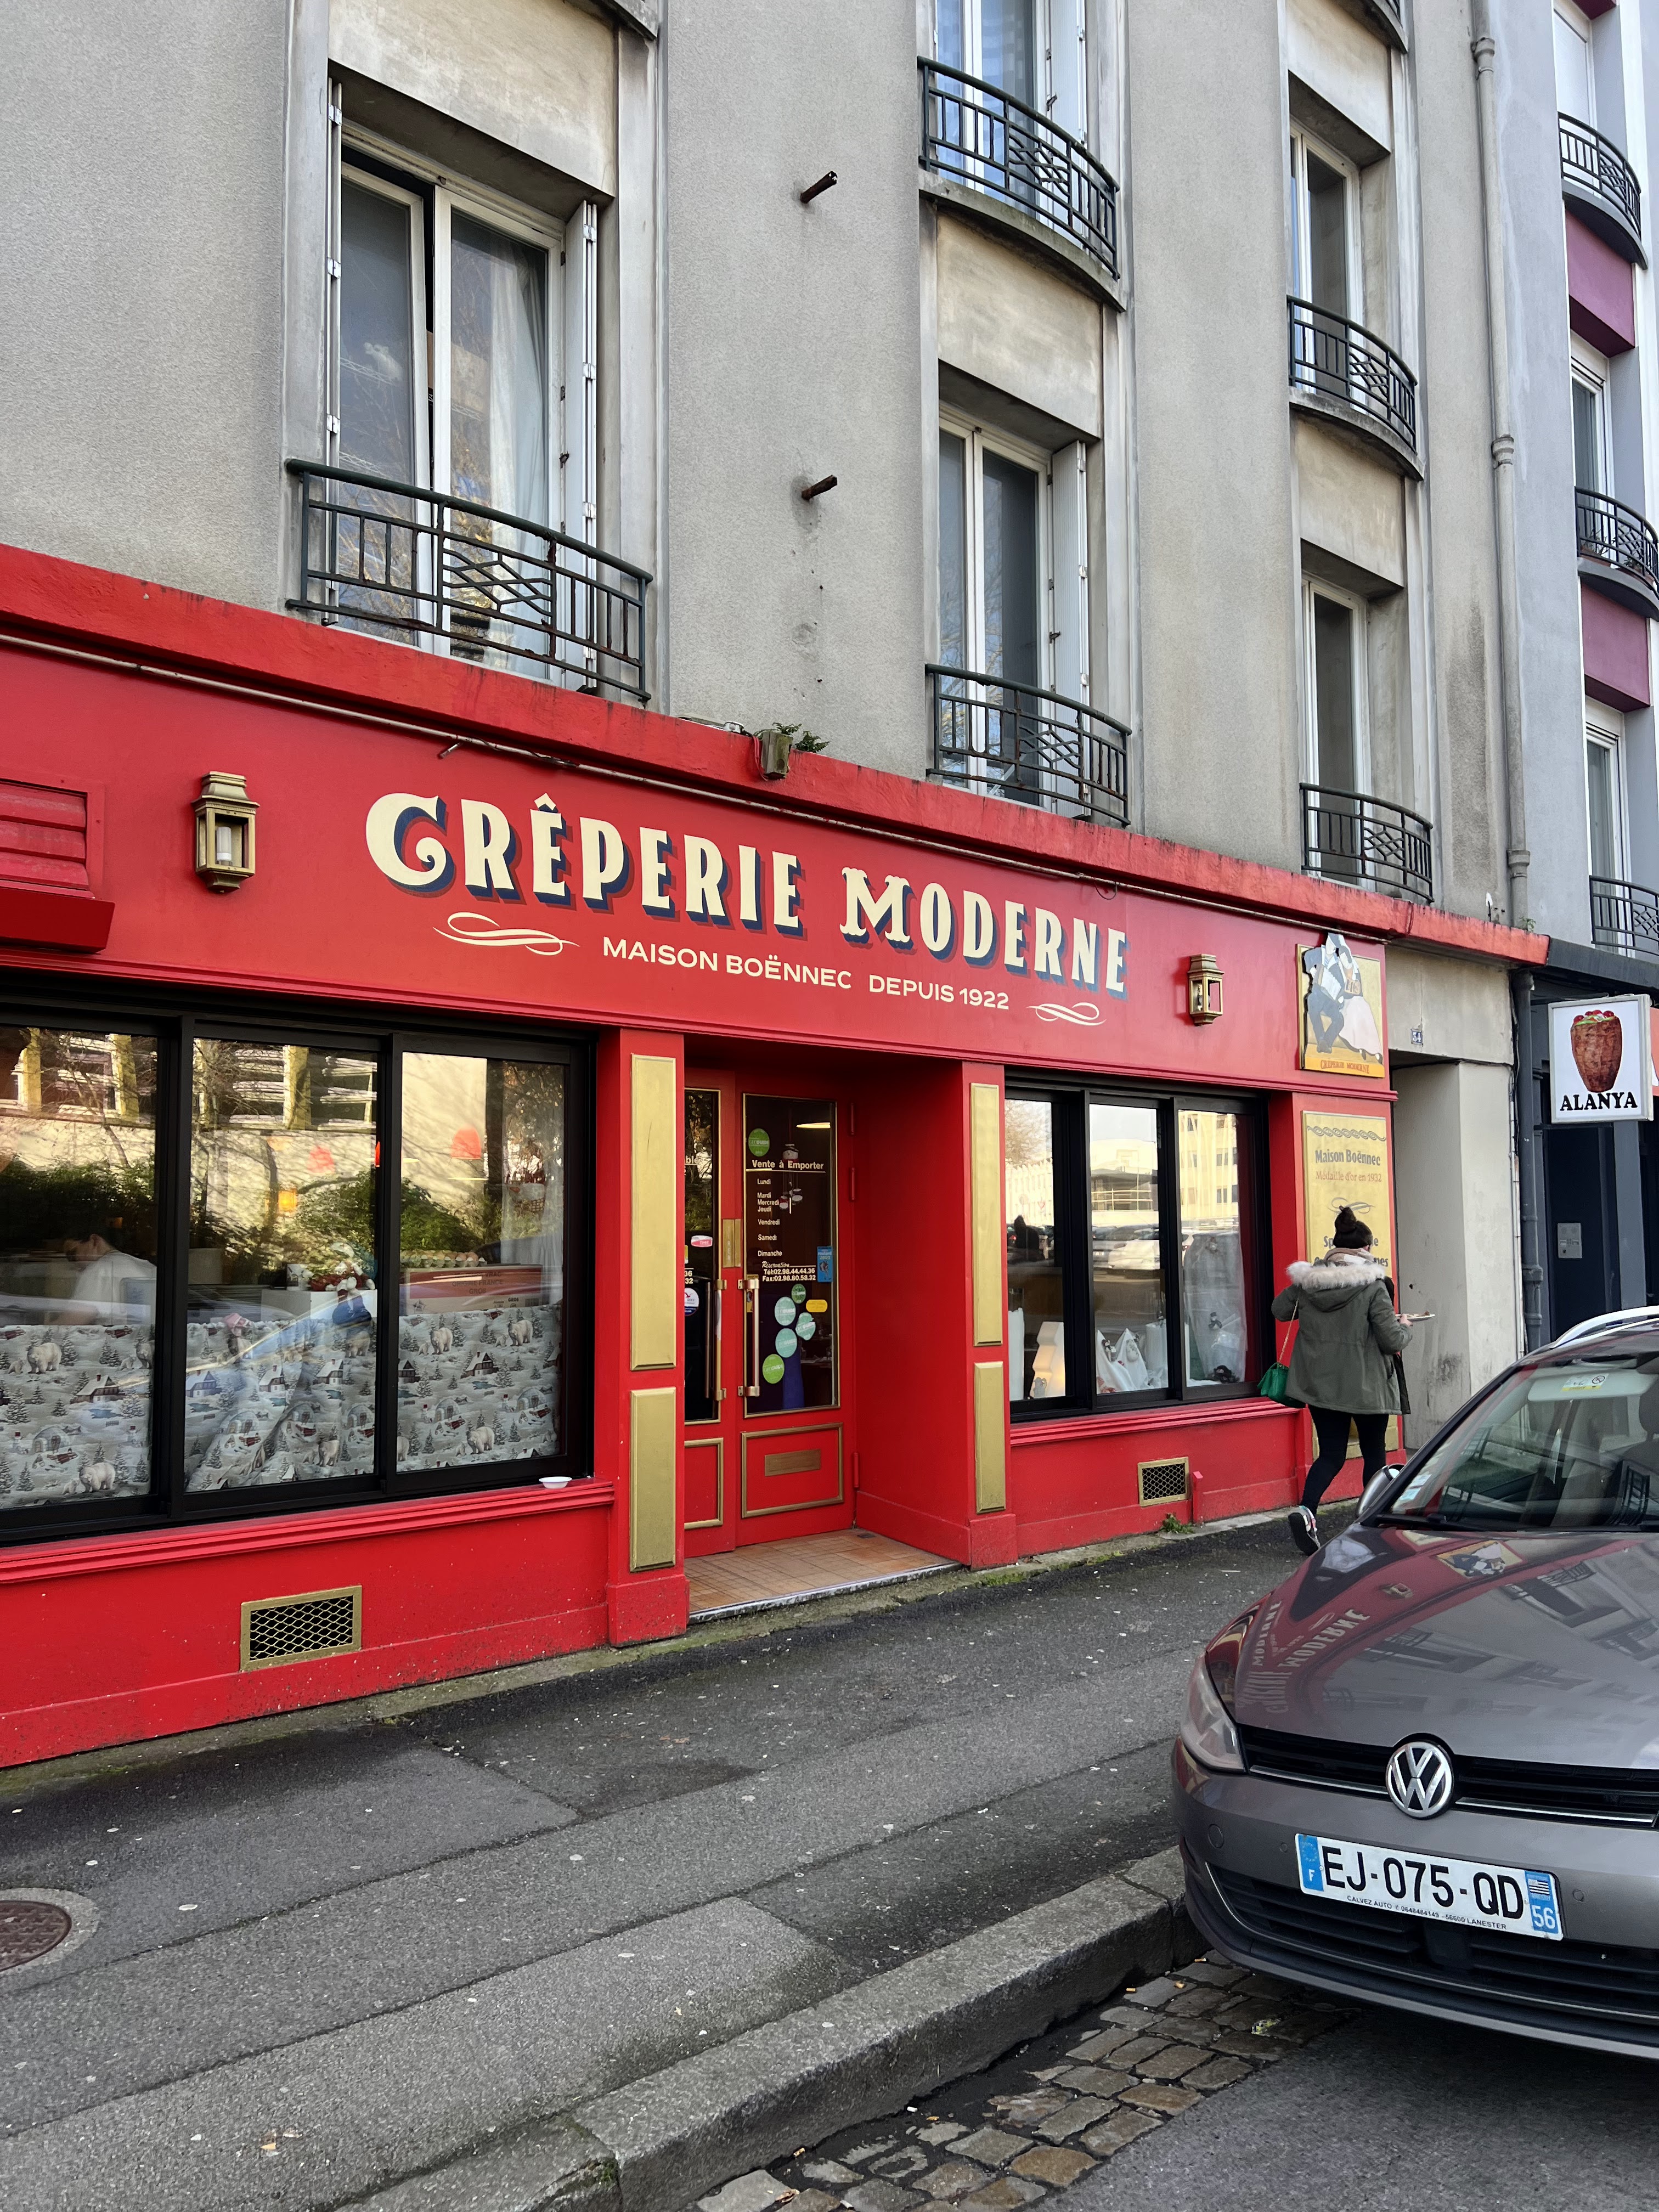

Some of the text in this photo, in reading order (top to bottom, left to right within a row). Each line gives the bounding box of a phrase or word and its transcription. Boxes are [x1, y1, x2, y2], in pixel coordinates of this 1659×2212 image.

[365, 792, 1127, 996] CRÊPERIE MODERNE
[603, 936, 1009, 1010] MAISON BOËNNEC DEPUIS 1922
[1412, 1031, 1421, 1042] 34
[1560, 1091, 1638, 1111] ALANYA
[787, 1160, 823, 1170] Emporter
[1315, 1149, 1380, 1166] Maison Boënnec
[1316, 1170, 1344, 1181] Médaille
[1345, 1171, 1356, 1181] d'or
[1367, 1173, 1382, 1182] 1932
[1308, 1846, 1556, 1929] F EJ-075-QD 56
[1347, 1895, 1372, 1905] CALVEZ
[1374, 1900, 1392, 1909] AUTO
[1467, 1919, 1506, 1930] LANESTER
